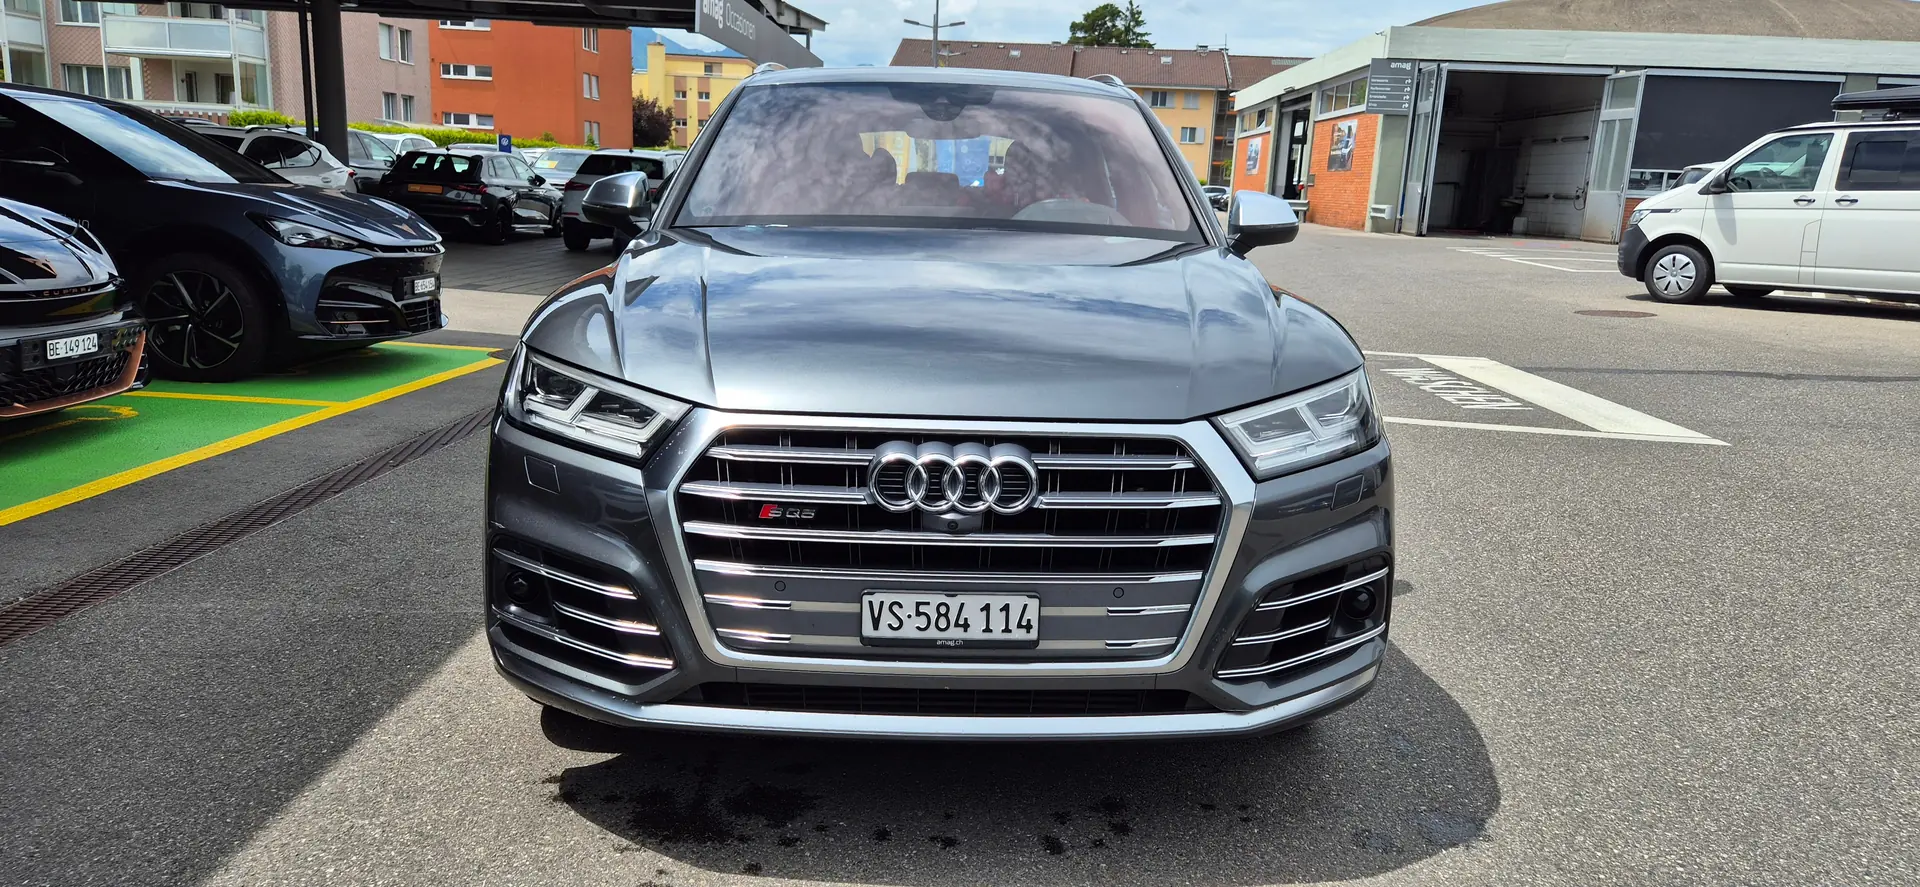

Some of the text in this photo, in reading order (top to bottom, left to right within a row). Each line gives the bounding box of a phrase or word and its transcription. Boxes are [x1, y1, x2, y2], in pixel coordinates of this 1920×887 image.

[1390, 62, 1412, 70] amag
[81, 336, 97, 351] 124
[1380, 367, 1534, 410] WASCHEN
[980, 602, 1034, 634] 114
[936, 639, 964, 647] amag.ch
